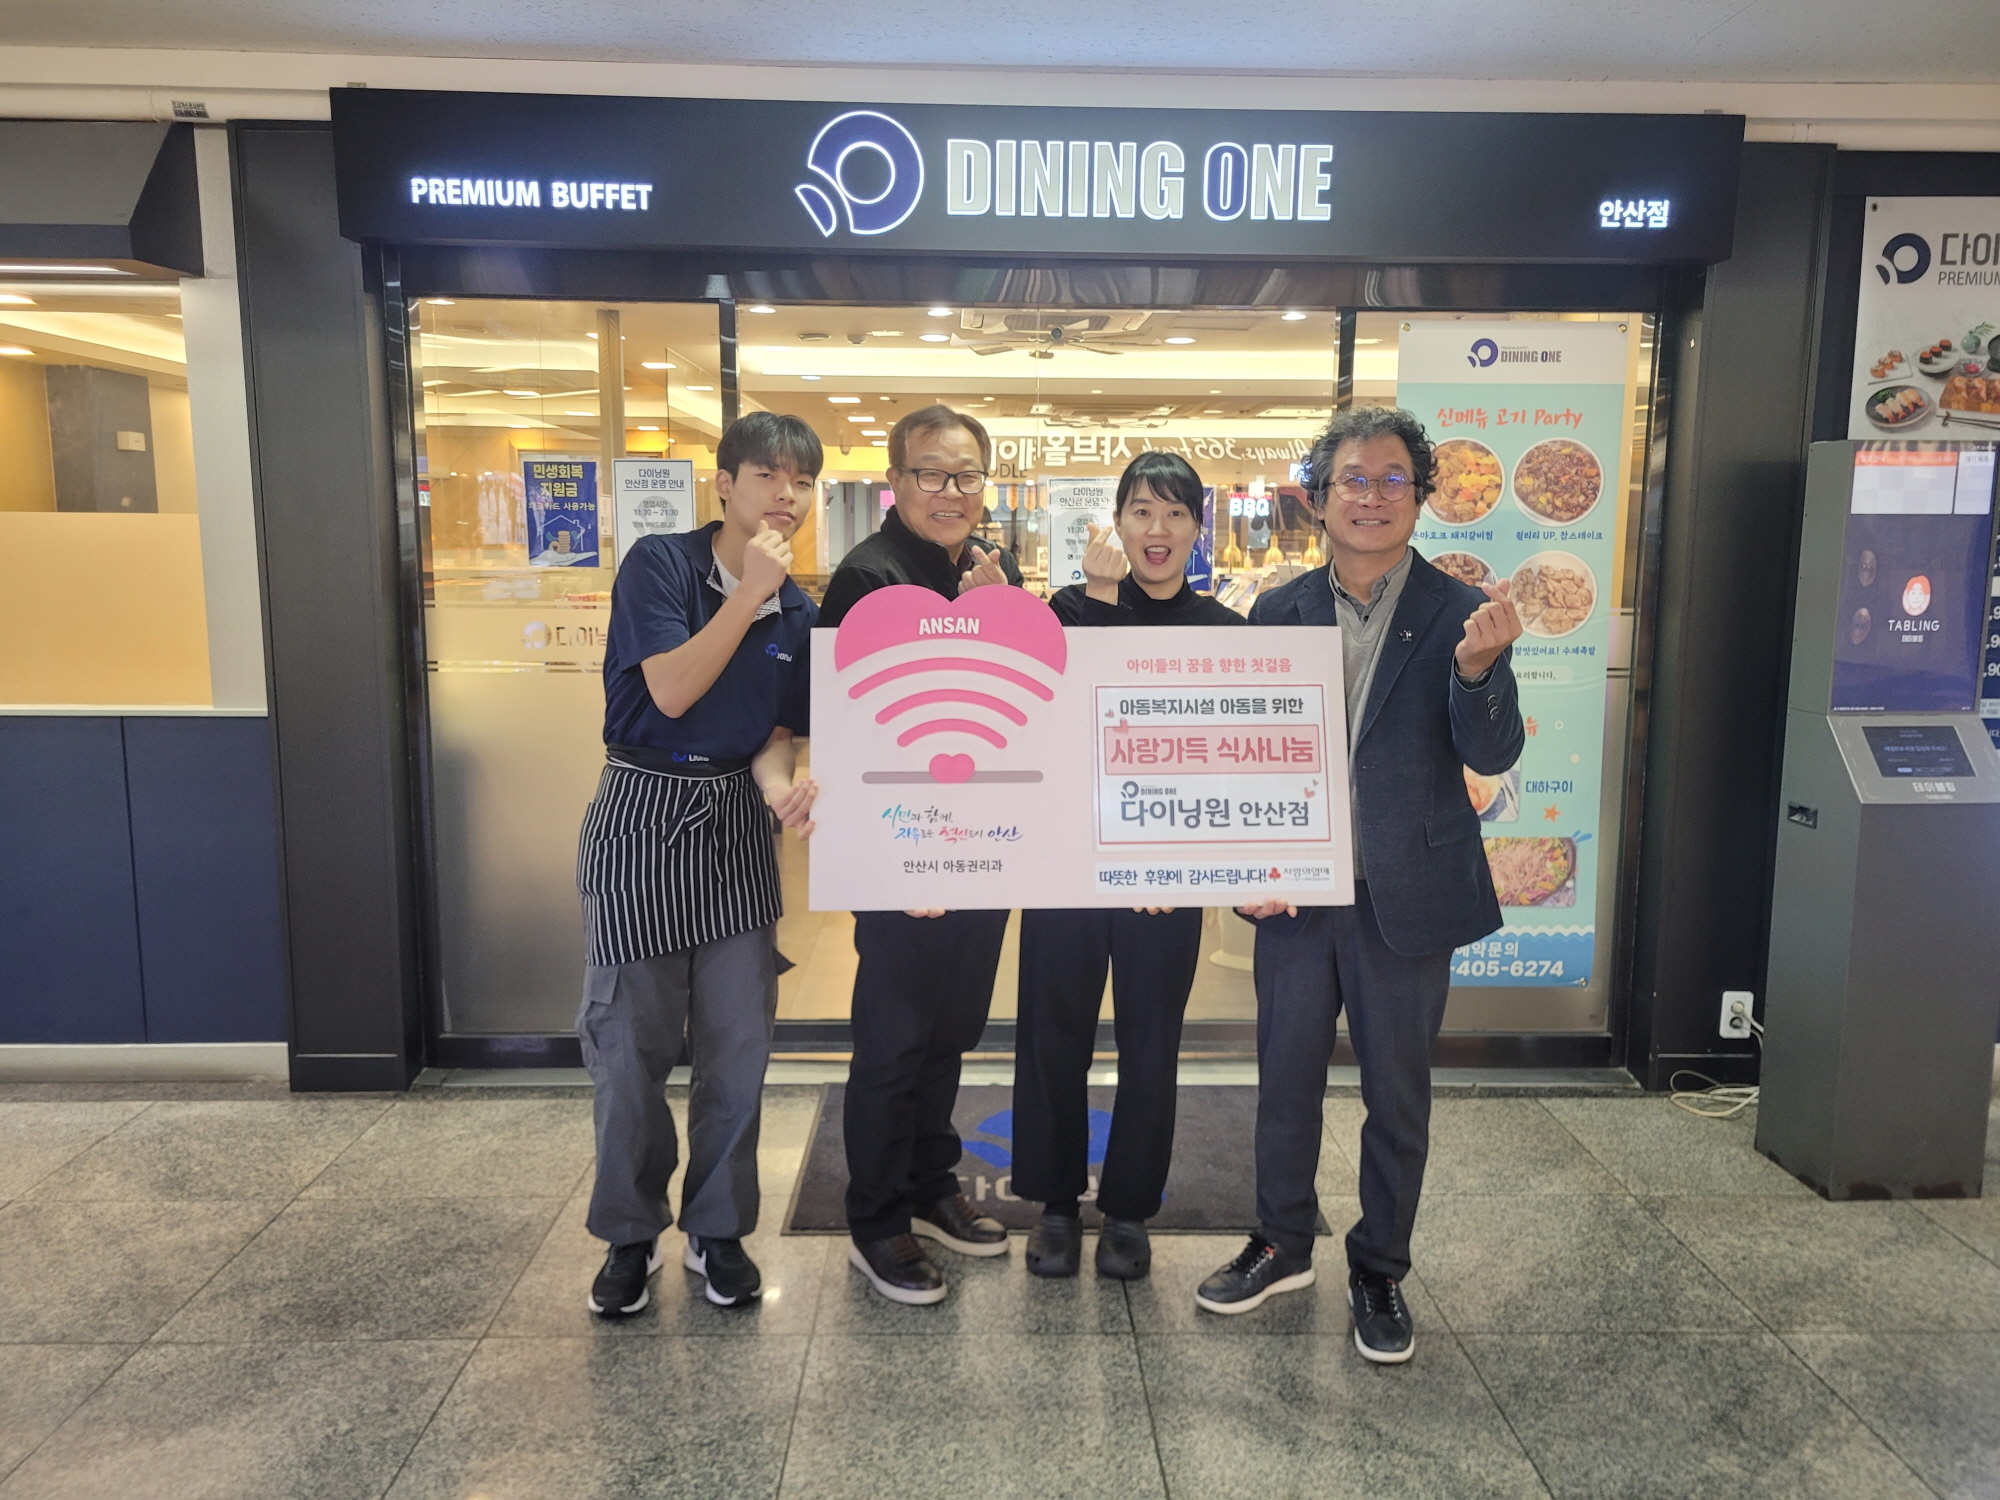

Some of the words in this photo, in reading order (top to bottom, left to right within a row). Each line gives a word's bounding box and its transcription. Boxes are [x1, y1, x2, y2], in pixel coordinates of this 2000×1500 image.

[946, 139, 1186, 220] DINING
[1203, 142, 1334, 222] ONE
[410, 177, 540, 207] PREMIUM
[552, 182, 653, 211] BUFFET
[1599, 199, 1670, 230] 안산점
[1938, 271, 2000, 286] PREMIU
[1501, 350, 1538, 363] DINING
[1541, 350, 1562, 363] ONE
[1437, 407, 1489, 429] 신메뉴
[1496, 408, 1527, 426] 고기
[1534, 408, 1583, 429] Party
[533, 464, 583, 479] 민생회복
[639, 468, 670, 478] 다이닝원
[625, 479, 648, 488] 안산점
[651, 479, 666, 488] 운영
[668, 479, 684, 488] 안내
[1073, 487, 1104, 496] 다이닝원
[563, 502, 596, 511] 사용가능
[643, 500, 668, 508] 영업시간
[1230, 498, 1270, 517] BBQ
[919, 617, 980, 635] ANSAN
[1888, 619, 1940, 631] TABLING
[1127, 659, 1182, 674] 아이들의
[1186, 658, 1214, 674] 꿈을
[1219, 658, 1246, 674] 향한
[1251, 658, 1292, 674] 첫걸음
[1119, 698, 1215, 716] 아동복지시설
[1220, 698, 1267, 715] 아동을
[1272, 697, 1304, 715] 위한
[1110, 737, 1209, 764] 사랑가득
[1217, 736, 1314, 763] 식사나눔
[1141, 788, 1163, 796] DINING
[1165, 787, 1177, 795] ONE
[1525, 780, 1573, 794] 대하구이
[1120, 798, 1231, 828] 다이닝원
[1238, 801, 1310, 827] 안산점
[988, 826, 1024, 841] 안산
[903, 860, 938, 873] 안산시
[943, 859, 1003, 873] 아동권리과
[1099, 870, 1138, 886] 따뜻한
[1144, 870, 1182, 885] 후원에
[1188, 869, 1267, 885] 감사드립니다!
